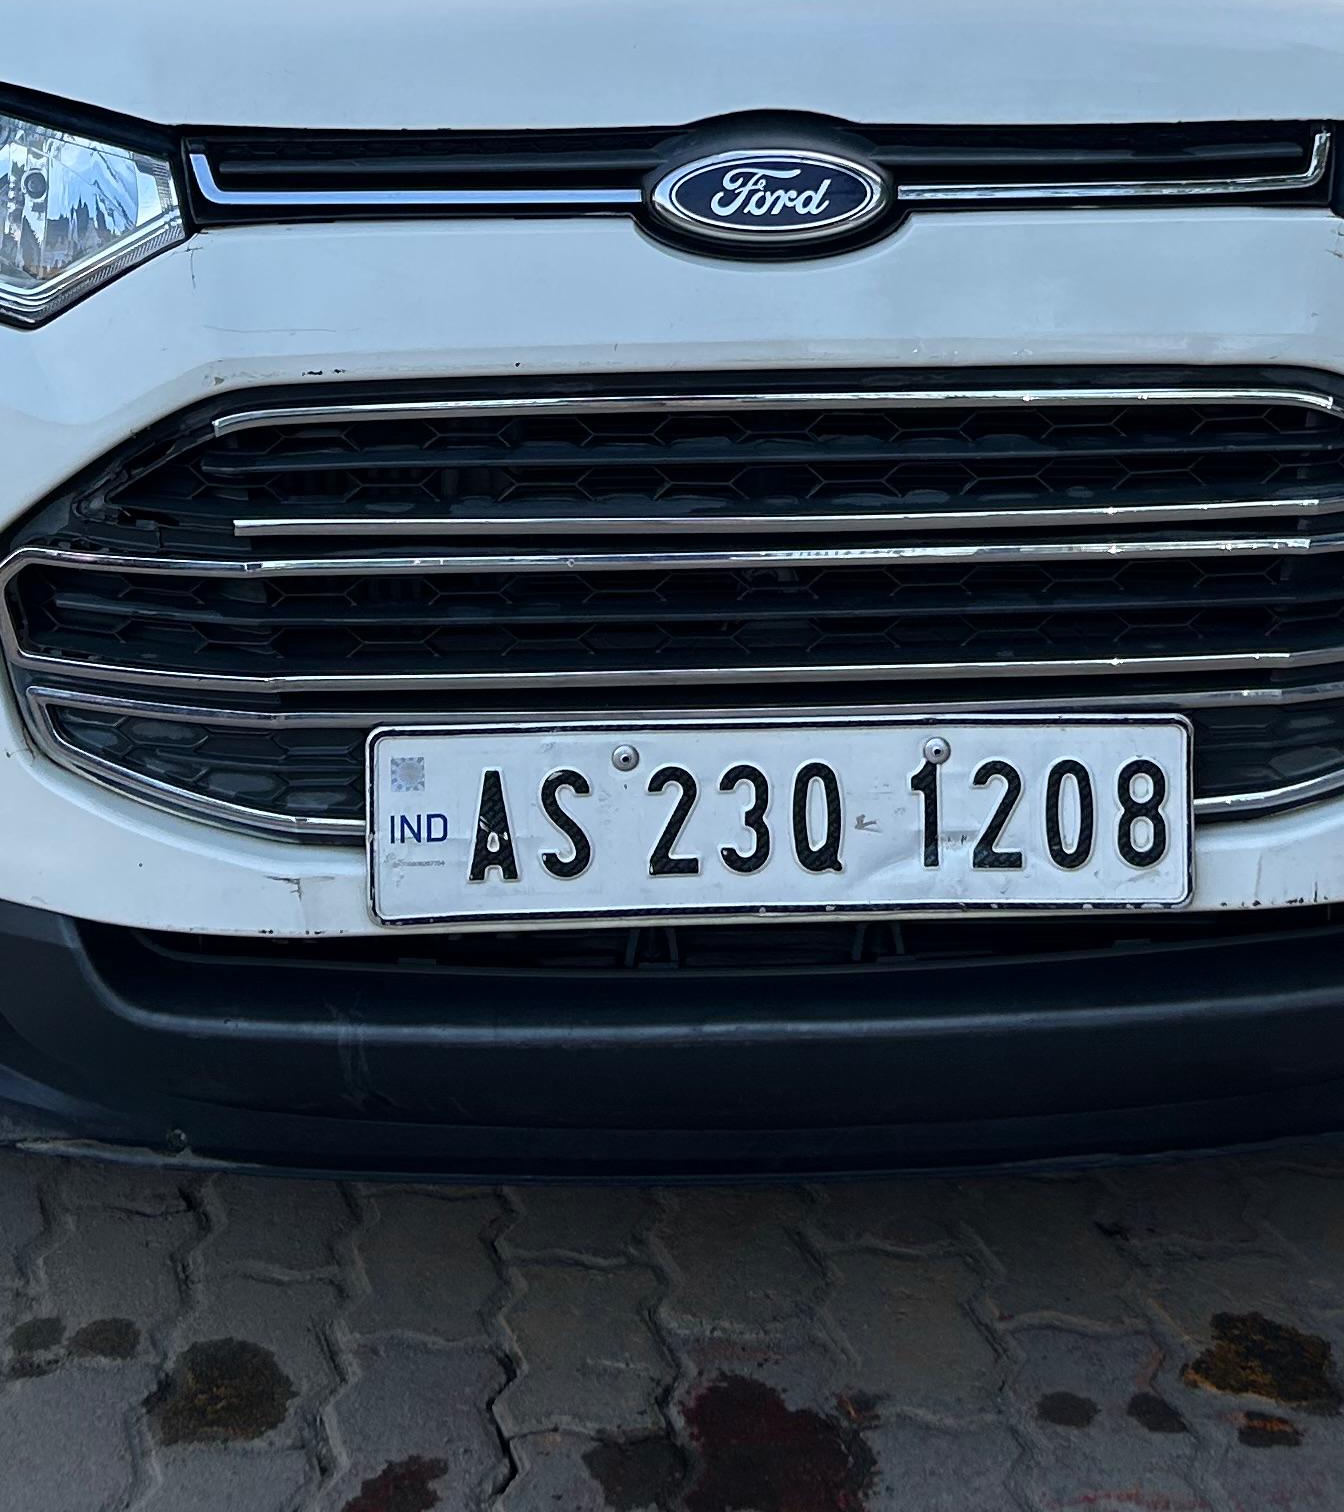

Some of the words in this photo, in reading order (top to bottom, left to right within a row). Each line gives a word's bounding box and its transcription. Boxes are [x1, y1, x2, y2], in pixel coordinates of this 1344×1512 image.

[710, 168, 831, 217] Ford
[390, 813, 448, 844] IND
[468, 769, 592, 881] AS
[646, 760, 844, 875] 23Q
[910, 758, 1166, 870] 1208
